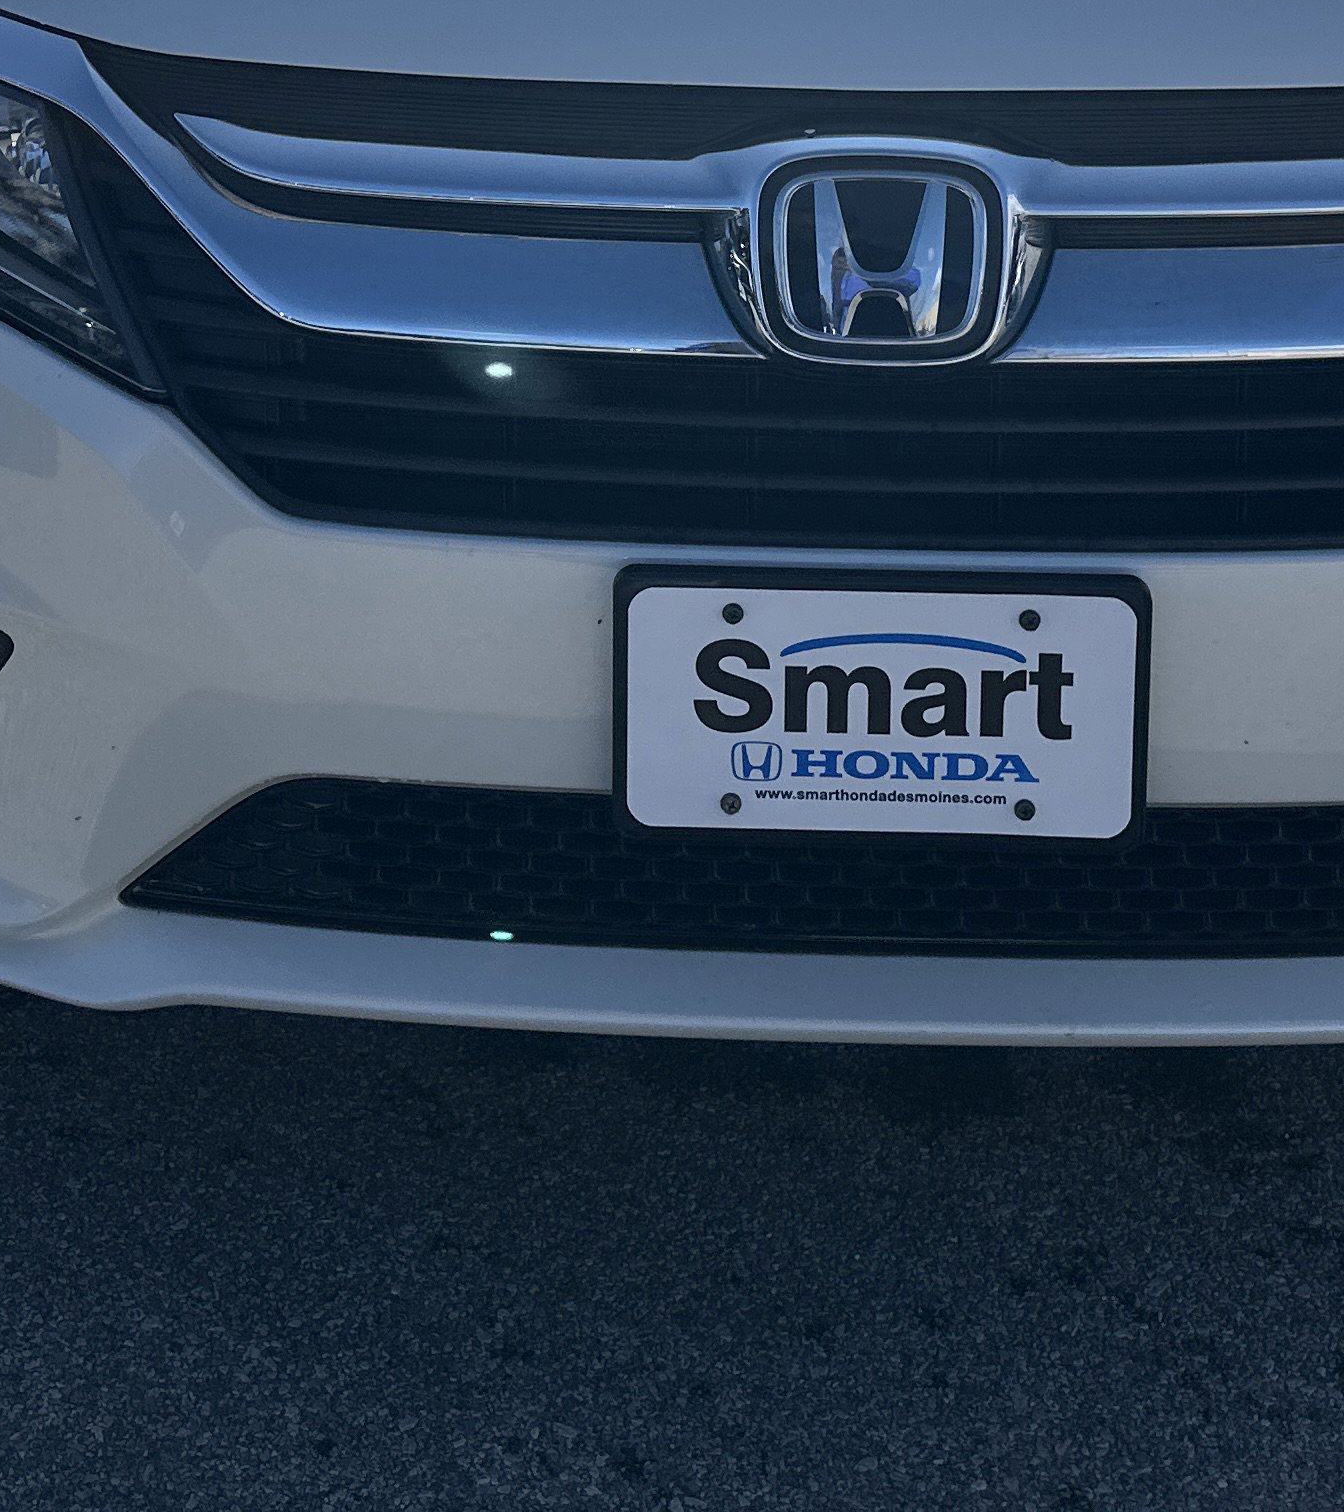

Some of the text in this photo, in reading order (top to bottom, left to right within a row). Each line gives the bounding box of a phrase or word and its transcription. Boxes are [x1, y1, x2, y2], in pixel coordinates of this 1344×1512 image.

[693, 638, 1074, 740] Smart
[791, 748, 1040, 783] HONDA
[754, 788, 1007, 805] www.smarthondadesmoines.com
